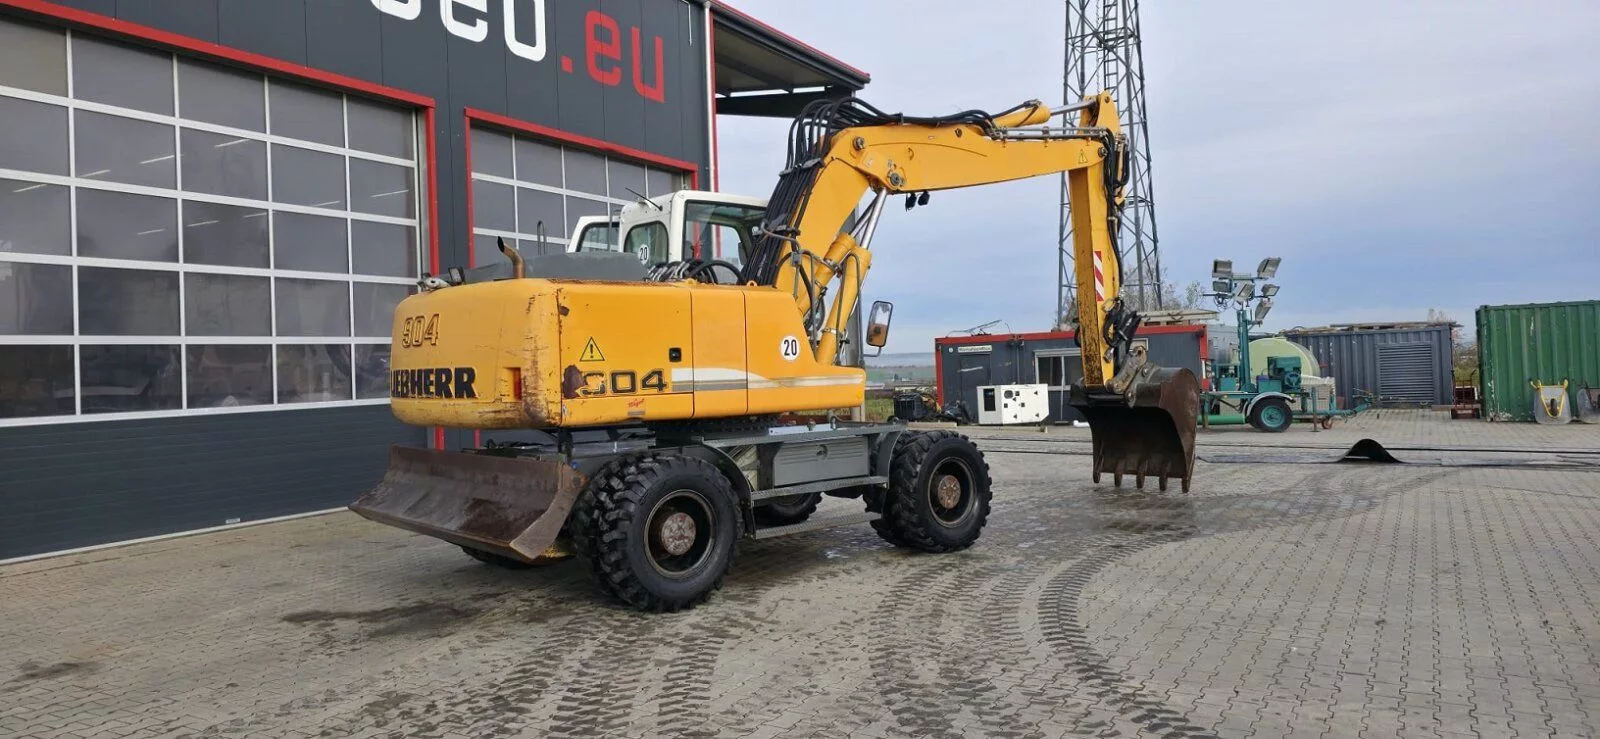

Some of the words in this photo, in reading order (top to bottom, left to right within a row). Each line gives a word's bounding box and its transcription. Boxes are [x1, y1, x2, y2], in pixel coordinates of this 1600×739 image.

[639, 246, 648, 261] 20
[402, 313, 440, 348] 904
[783, 339, 798, 356] 20
